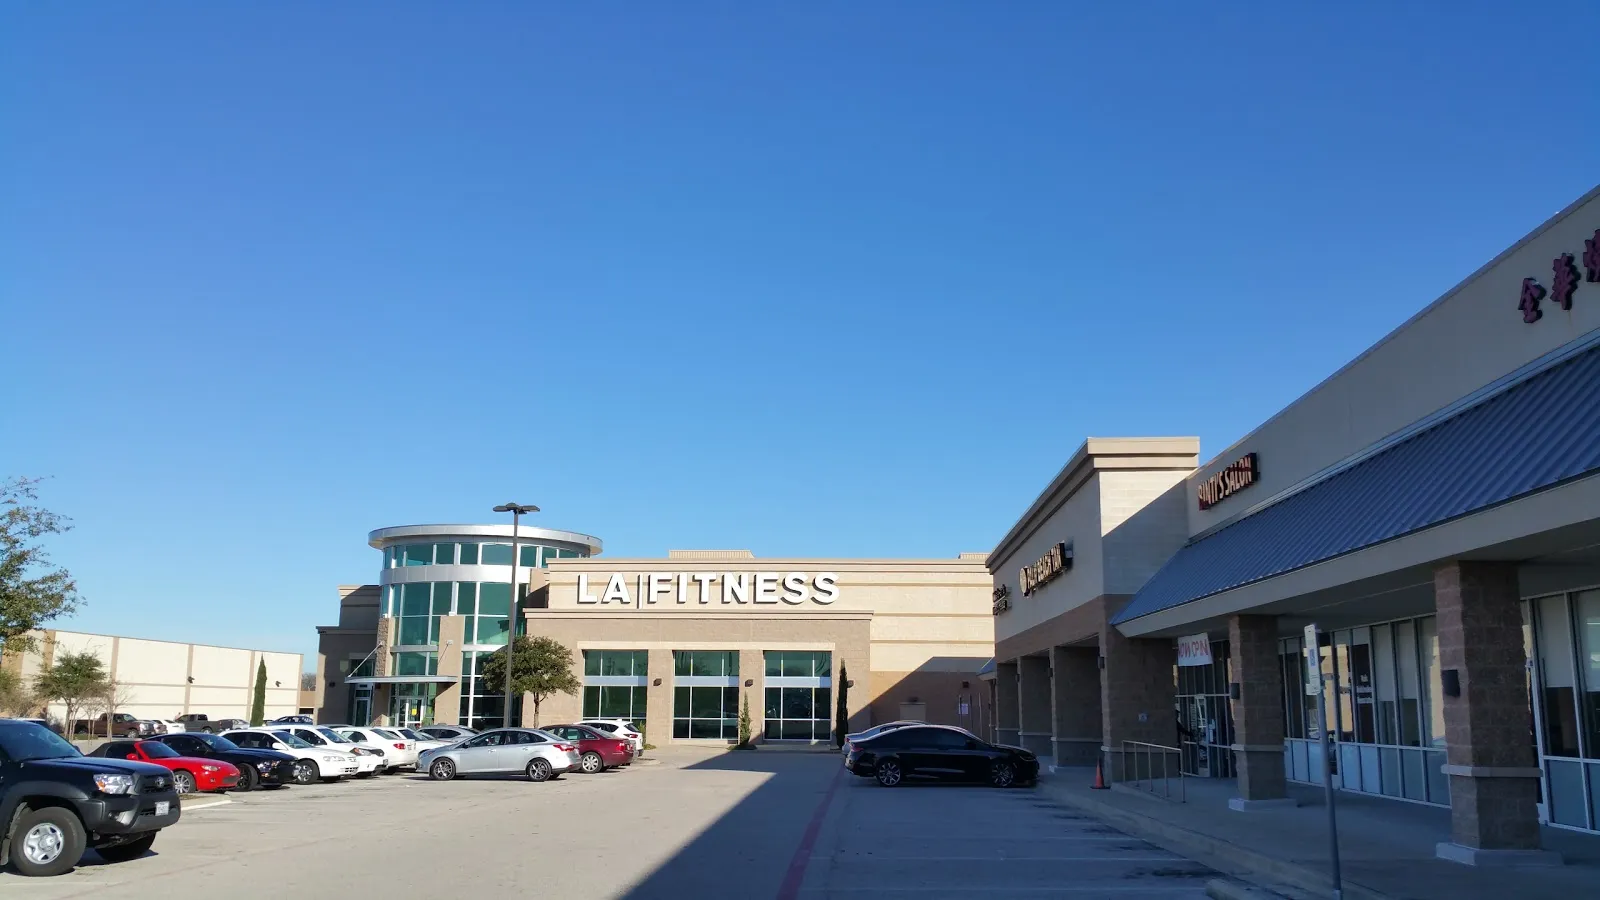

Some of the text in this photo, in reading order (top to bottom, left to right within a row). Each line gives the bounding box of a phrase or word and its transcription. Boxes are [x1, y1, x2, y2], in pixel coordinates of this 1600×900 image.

[1225, 456, 1253, 496] SALON
[577, 572, 840, 605] LA FITNESS
